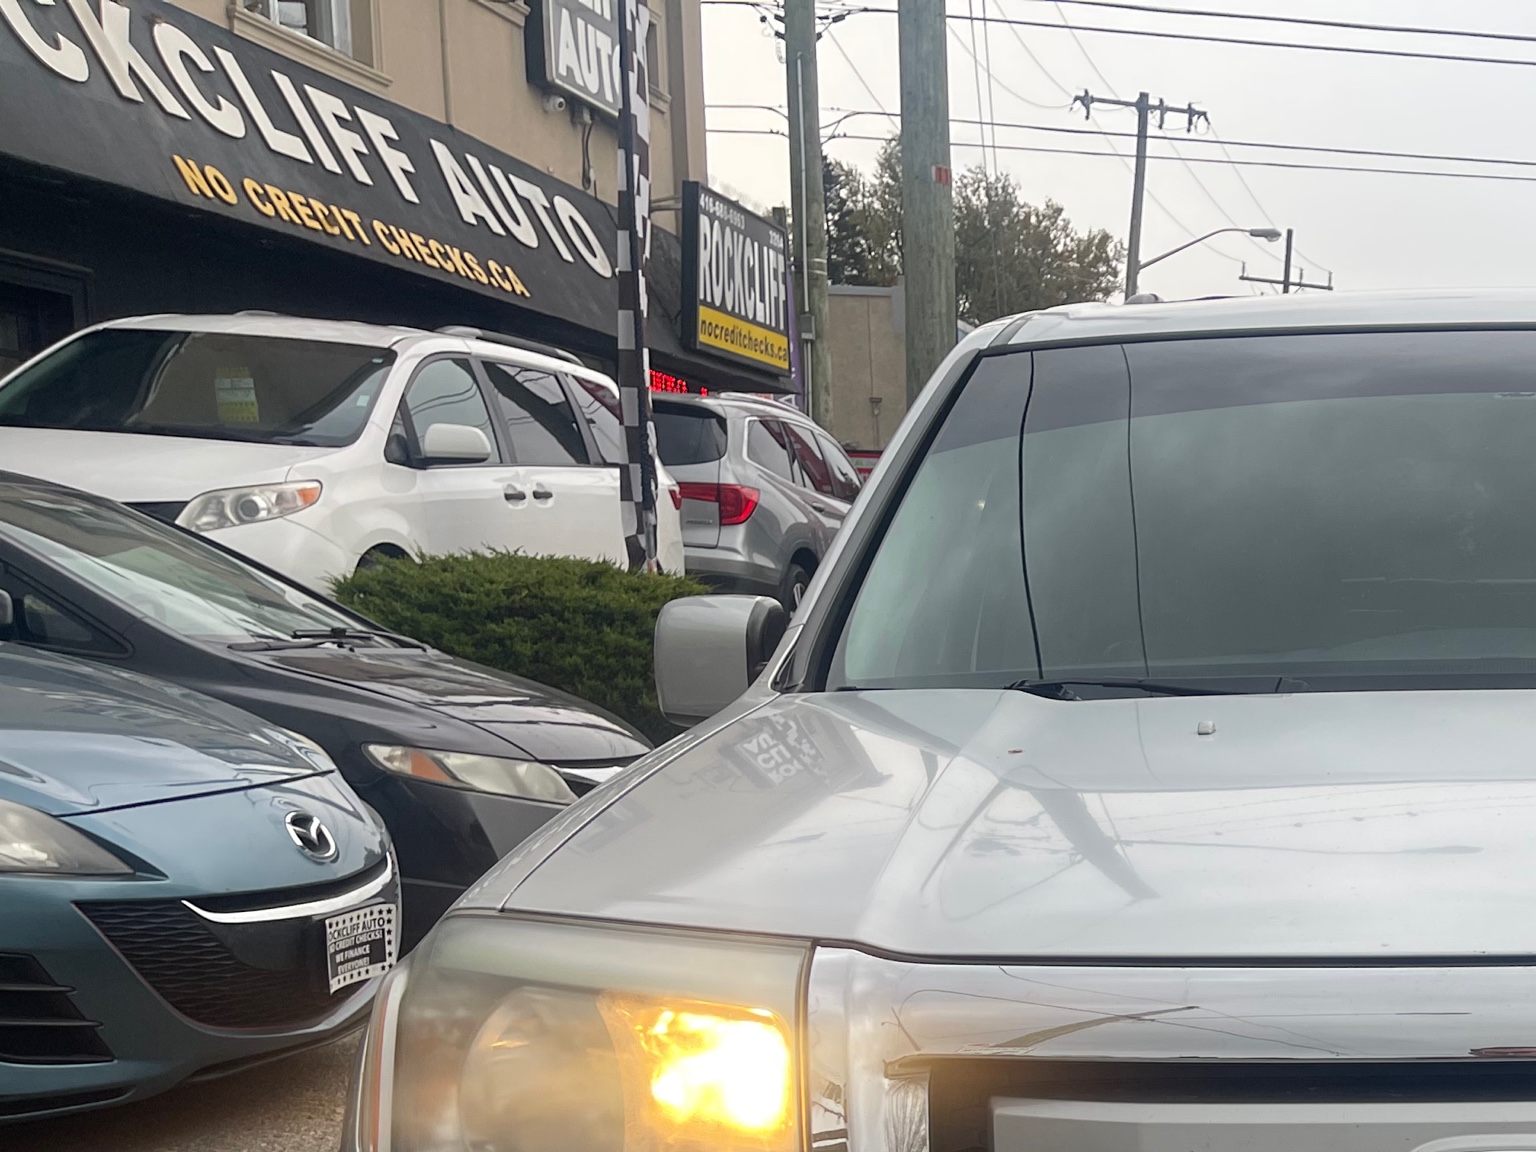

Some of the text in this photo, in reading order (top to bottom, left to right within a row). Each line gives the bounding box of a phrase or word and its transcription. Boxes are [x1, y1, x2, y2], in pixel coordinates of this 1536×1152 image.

[172, 154, 238, 205] NO
[372, 219, 531, 298] CHECKS.CA
[430, 138, 613, 279] AUTO
[700, 213, 787, 331] ROCKCLIFF
[700, 318, 788, 363] nocreditchecks.ca
[362, 917, 385, 931] AUTO
